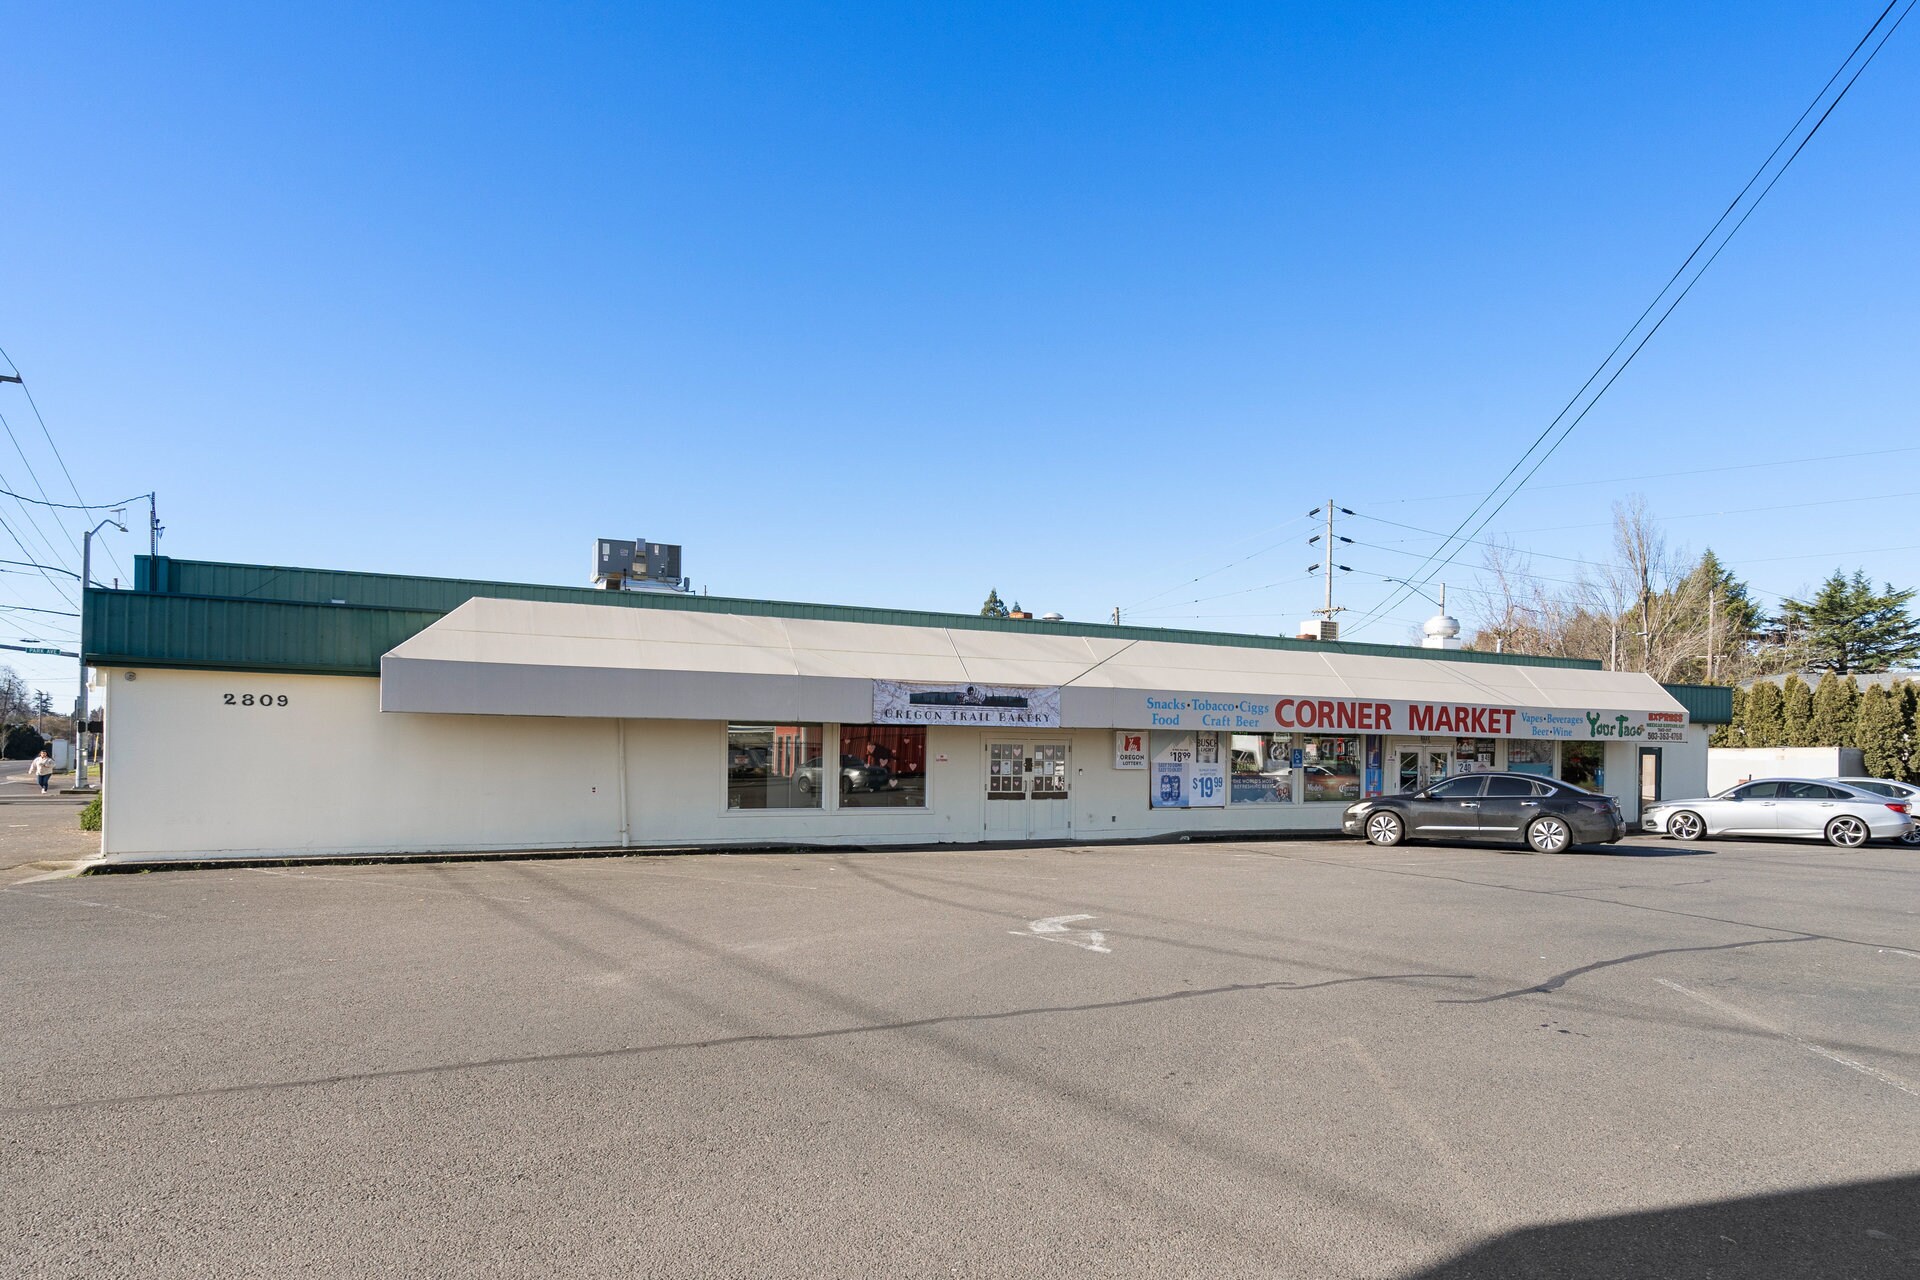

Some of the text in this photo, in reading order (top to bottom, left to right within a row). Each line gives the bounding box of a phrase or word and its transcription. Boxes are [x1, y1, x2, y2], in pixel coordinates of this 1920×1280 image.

[224, 694, 288, 706] 2809
[1146, 697, 1269, 715] Snacks Tobacco Ciggs
[884, 709, 1051, 723] OREGON TRAIL BAKERY
[1152, 713, 1260, 728] Food Craft Beer
[1274, 698, 1516, 734] CORNER MARKET
[1521, 712, 1583, 726] Vapes Beverages
[1532, 725, 1573, 737] Beer Wine
[1586, 711, 1643, 737] Your Taco
